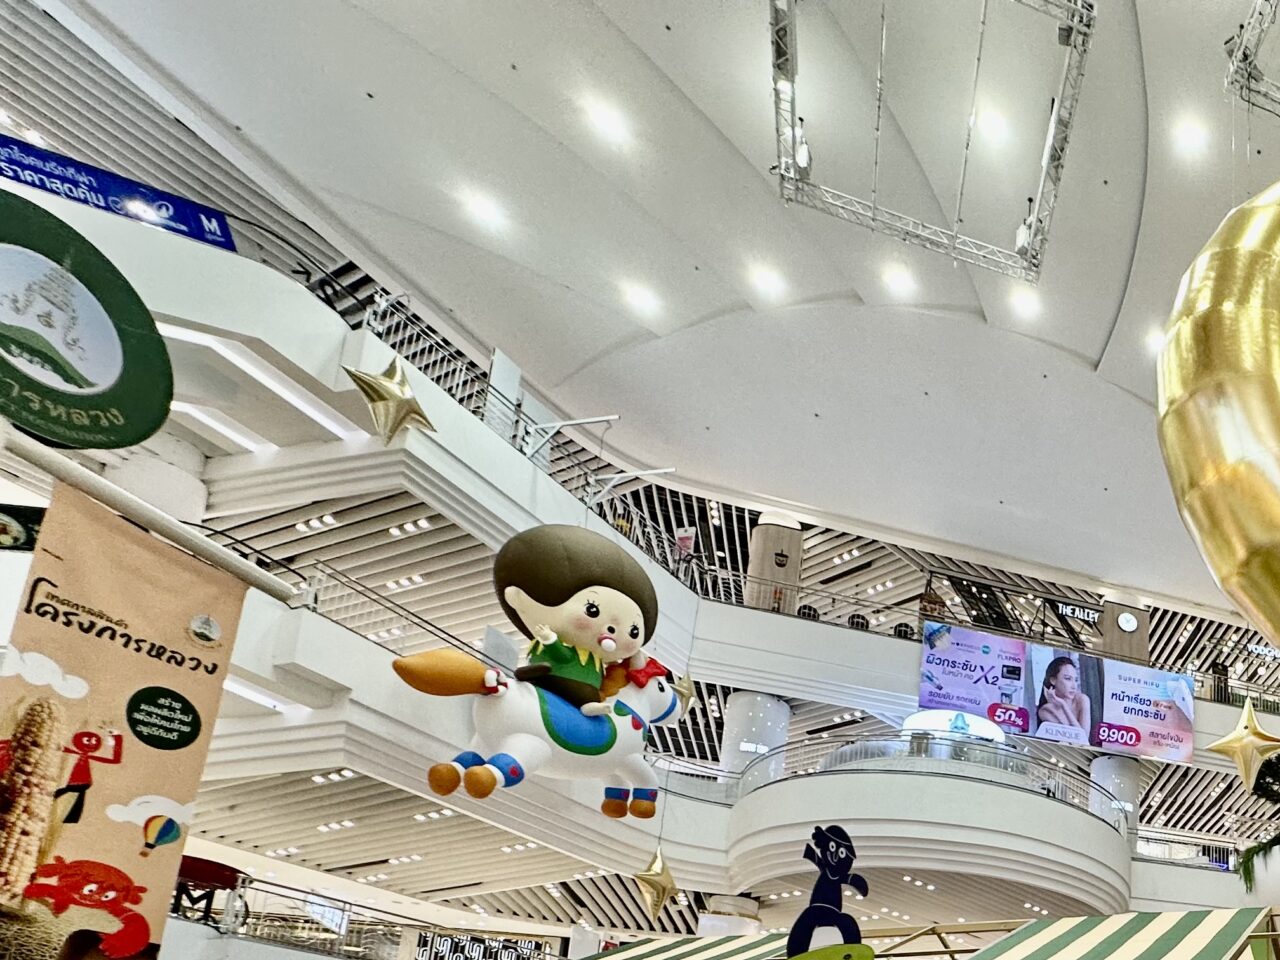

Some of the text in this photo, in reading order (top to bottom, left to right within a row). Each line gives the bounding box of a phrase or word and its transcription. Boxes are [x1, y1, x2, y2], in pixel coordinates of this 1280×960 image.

[200, 213, 221, 236] M
[1058, 604, 1100, 622] THE ALLEY
[24, 577, 218, 675] โครงการหลวง
[926, 654, 977, 672] ผิวกระชับ
[1118, 675, 1141, 684] SUPER
[1111, 691, 1152, 707] หน้าเรียว
[994, 708, 1024, 726] 50%
[1123, 706, 1166, 721] ยกกระชับ
